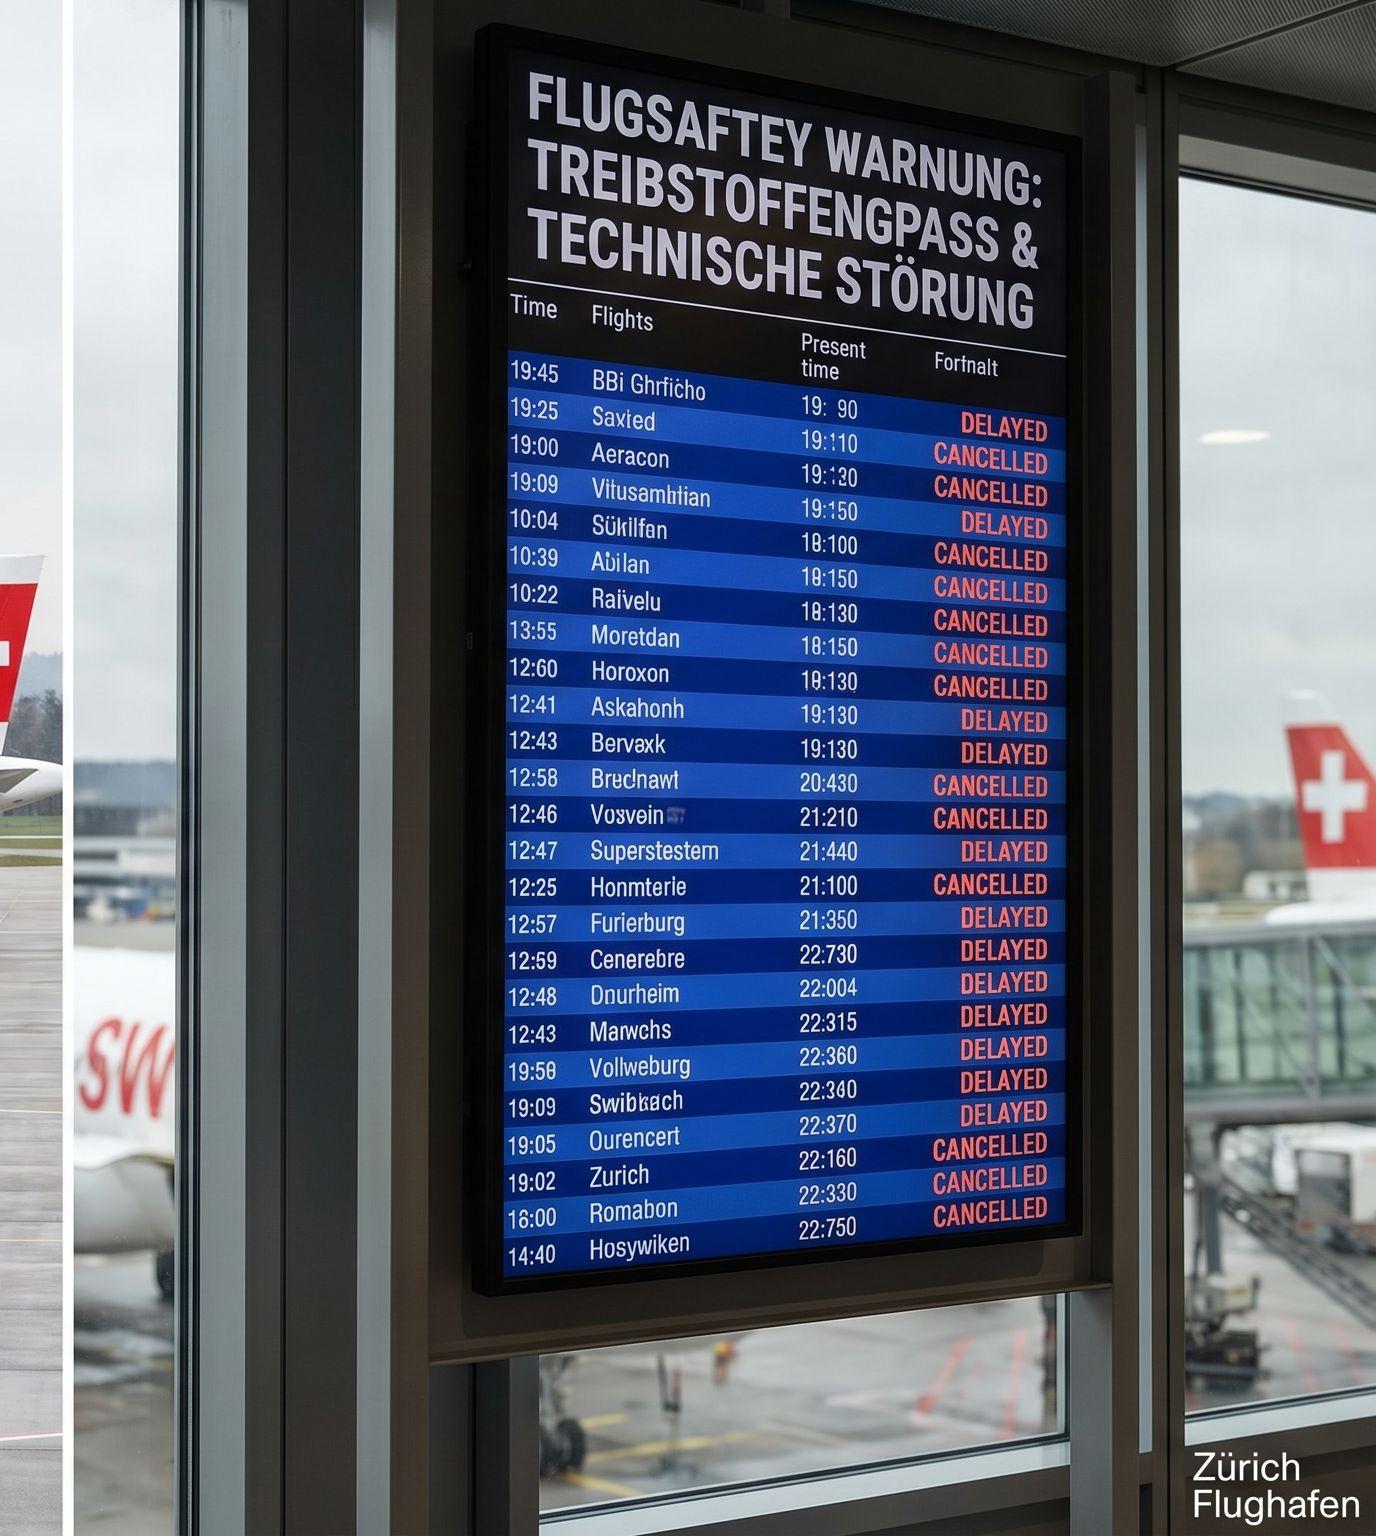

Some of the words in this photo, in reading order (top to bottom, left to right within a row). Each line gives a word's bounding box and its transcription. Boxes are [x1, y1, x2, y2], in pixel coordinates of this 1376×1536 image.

[529, 71, 813, 167] FLUGSAFTEY
[824, 126, 1042, 209] WARNUNG:
[527, 138, 999, 262] TREIBSTOFFENGPASS
[1011, 221, 1039, 270] &
[527, 207, 823, 300] TECHNISCHE
[836, 253, 1034, 330] STÖRUNG
[509, 293, 558, 319] Time
[592, 304, 654, 332] Flights
[801, 332, 867, 360] Present
[801, 358, 840, 381] time
[511, 359, 559, 384] 19:45
[961, 411, 1048, 442] DELAYED
[510, 396, 558, 421] 19:25
[934, 441, 1048, 475] CANCELLED
[510, 433, 559, 458] 19:00
[591, 442, 669, 469] Aeracon
[934, 474, 1048, 507] CANCELLED
[510, 471, 558, 494] 19:09
[961, 510, 1048, 539] DELAYED
[510, 508, 559, 531] 10:04
[934, 541, 1048, 572] CANCELLED
[510, 545, 558, 567] 10:39
[934, 575, 1048, 604] CANCELLED
[510, 583, 558, 604] 10:22
[934, 608, 1048, 637] CANCELLED
[509, 620, 557, 641] 13:55
[592, 624, 680, 648] Moretdan
[934, 641, 1048, 669] CANCELLED
[509, 657, 558, 678] 12:60
[592, 660, 669, 683] Horoxon
[934, 674, 1048, 701] CANCELLED
[509, 694, 555, 714] 12:41
[591, 696, 684, 719] Askahonh
[801, 703, 858, 725] 19:130
[961, 708, 1048, 733] DELAYED
[509, 730, 558, 751] 12:43
[801, 738, 858, 760] 19:130
[961, 741, 1048, 765] DELAYED
[509, 767, 558, 788] 12:58
[800, 772, 858, 793] 20:430
[933, 774, 1048, 797] CANCELLED
[509, 803, 558, 824] 12:46
[800, 806, 858, 828] 21:210
[933, 807, 1048, 830] CANCELLED
[509, 840, 558, 860] 12:47
[800, 840, 858, 862] 21:440
[961, 840, 1048, 862] DELAYED
[509, 877, 557, 897] 12:25
[591, 875, 687, 898] Honmterie
[800, 874, 858, 896] 21:100
[933, 872, 1048, 896] CANCELLED
[508, 914, 557, 934] 12:57
[591, 911, 685, 937] Furierburg
[799, 909, 858, 930] 21:350
[961, 906, 1048, 929] DELAYED
[508, 950, 557, 970] 12:59
[590, 948, 685, 970] Cenerebre
[800, 943, 858, 965] 22:730
[961, 938, 1048, 962] DELAYED
[508, 986, 557, 1007] 12:48
[799, 977, 858, 998] 22:004
[961, 970, 1048, 995] DELAYED
[509, 1024, 556, 1044] 12:43
[799, 1011, 857, 1033] 22:315
[961, 1003, 1048, 1028] DELAYED
[589, 1054, 691, 1080] Vollweburg
[799, 1045, 857, 1067] 22:360
[960, 1035, 1048, 1061] DELAYED
[509, 1097, 556, 1118] 19:09
[960, 1067, 1048, 1094] DELAYED
[508, 1134, 556, 1156] 19:05
[589, 1126, 680, 1152] Ourencert
[799, 1113, 857, 1136] 22:370
[960, 1100, 1048, 1127] DELAYED
[508, 1170, 556, 1193] 19:02
[589, 1163, 649, 1188] Zurich
[799, 1147, 857, 1171] 22:160
[933, 1132, 1048, 1162] CANCELLED
[590, 1198, 678, 1224] Romabon
[799, 1181, 857, 1206] 22:330
[933, 1164, 1048, 1195] CANCELLED
[508, 1244, 556, 1267] 14:40
[590, 1233, 690, 1262] Hosywiken
[799, 1216, 857, 1241] 22:750
[933, 1196, 1048, 1228] CANCELLED
